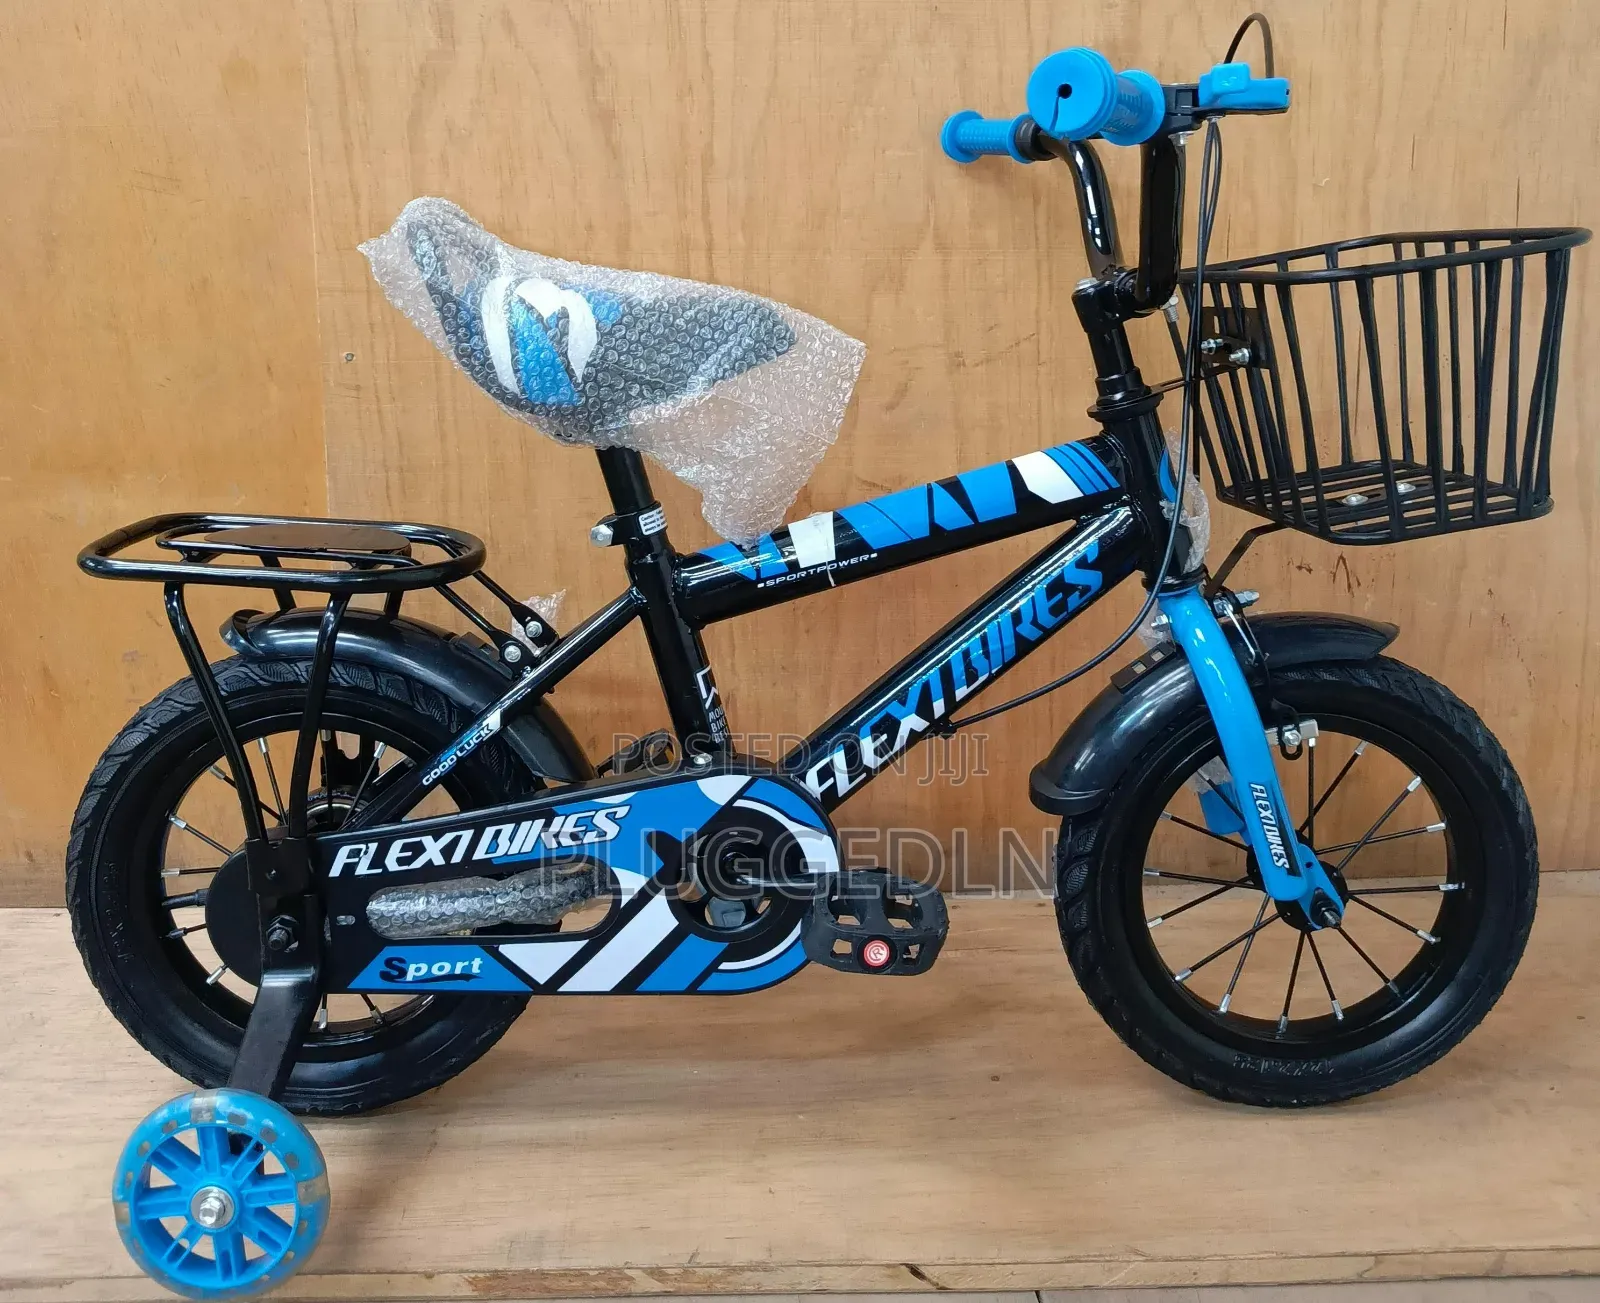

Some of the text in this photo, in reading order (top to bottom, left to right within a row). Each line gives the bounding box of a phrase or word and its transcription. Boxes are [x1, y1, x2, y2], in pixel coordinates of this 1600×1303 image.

[766, 554, 870, 587] SPORTPOWER
[422, 723, 495, 785] GOOD LUCK
[379, 956, 483, 983] Sport
